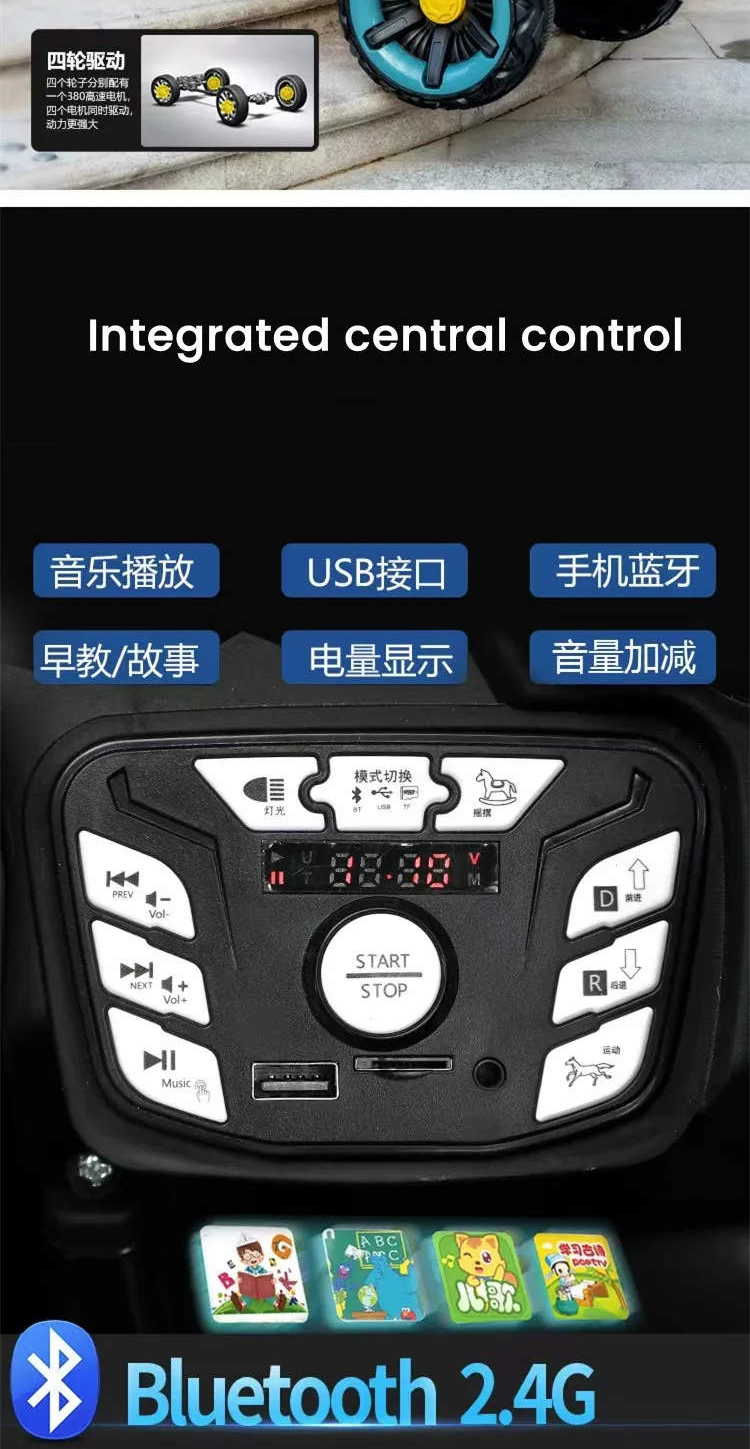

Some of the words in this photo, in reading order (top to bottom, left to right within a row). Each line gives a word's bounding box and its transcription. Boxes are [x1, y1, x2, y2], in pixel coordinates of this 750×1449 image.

[354, 769, 413, 784] 模式切换
[264, 806, 286, 817] 灯光
[468, 852, 480, 865] V
[112, 890, 134, 899] PREV
[600, 890, 614, 907] D
[625, 893, 642, 903] 前进
[149, 909, 170, 919] Vol-
[355, 953, 411, 969] START
[130, 981, 153, 990] NEXT
[589, 974, 602, 992] R
[361, 984, 408, 999] STOP
[163, 994, 188, 1004] Vol+
[602, 1045, 621, 1055] 运动
[161, 1078, 192, 1089] Music
